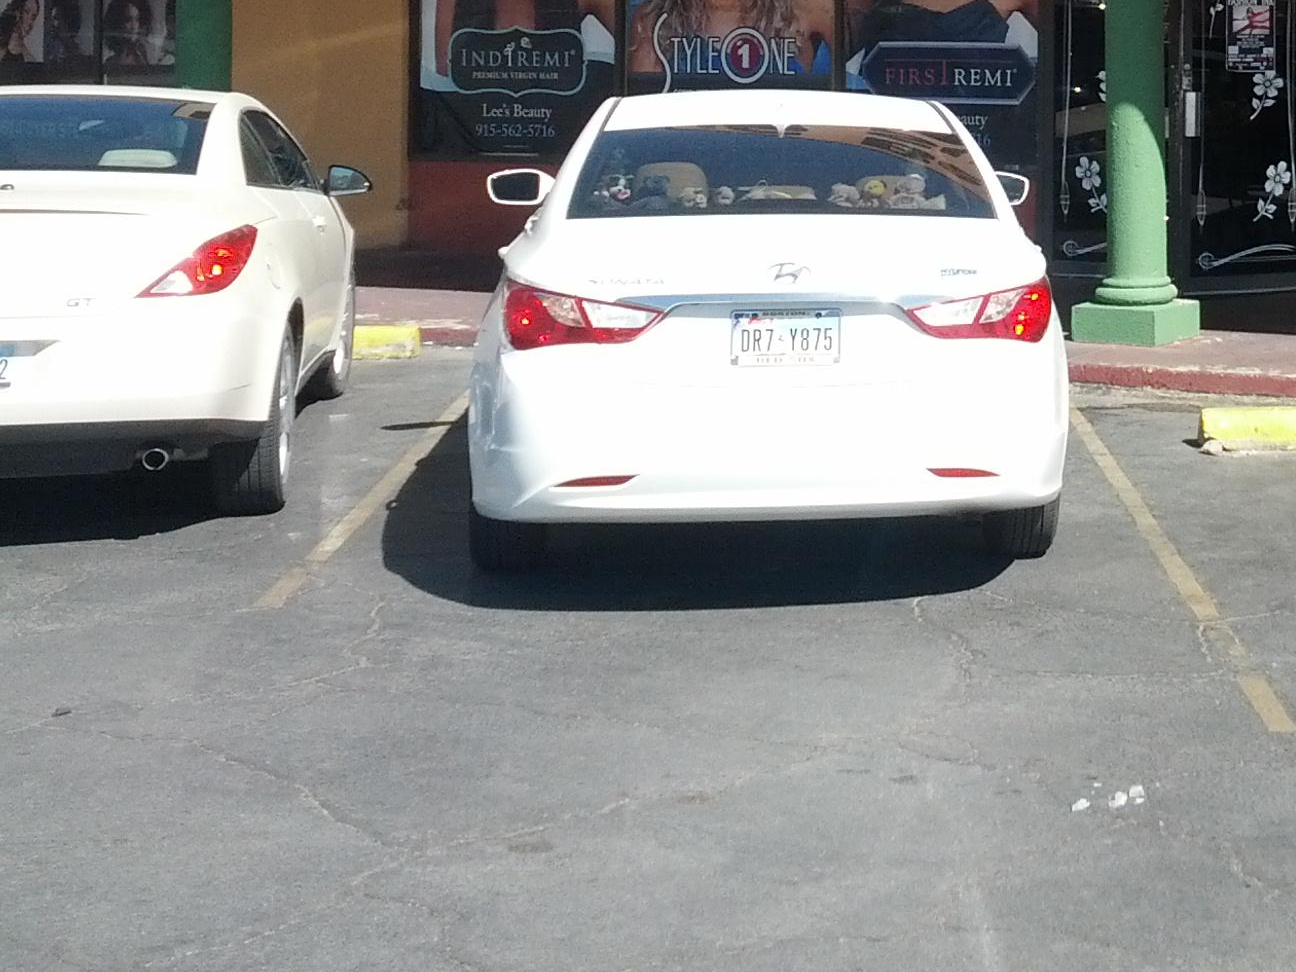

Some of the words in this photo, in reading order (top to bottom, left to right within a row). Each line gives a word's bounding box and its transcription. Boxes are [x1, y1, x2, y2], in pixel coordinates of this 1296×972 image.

[472, 71, 508, 79] PREMIUM
[510, 71, 538, 79] VIRGIN
[539, 72, 559, 80] HAIR
[482, 103, 510, 118] Lee's
[513, 104, 552, 122] Beauty
[475, 123, 555, 138] 915-562-5716
[790, 327, 833, 352] Y875
